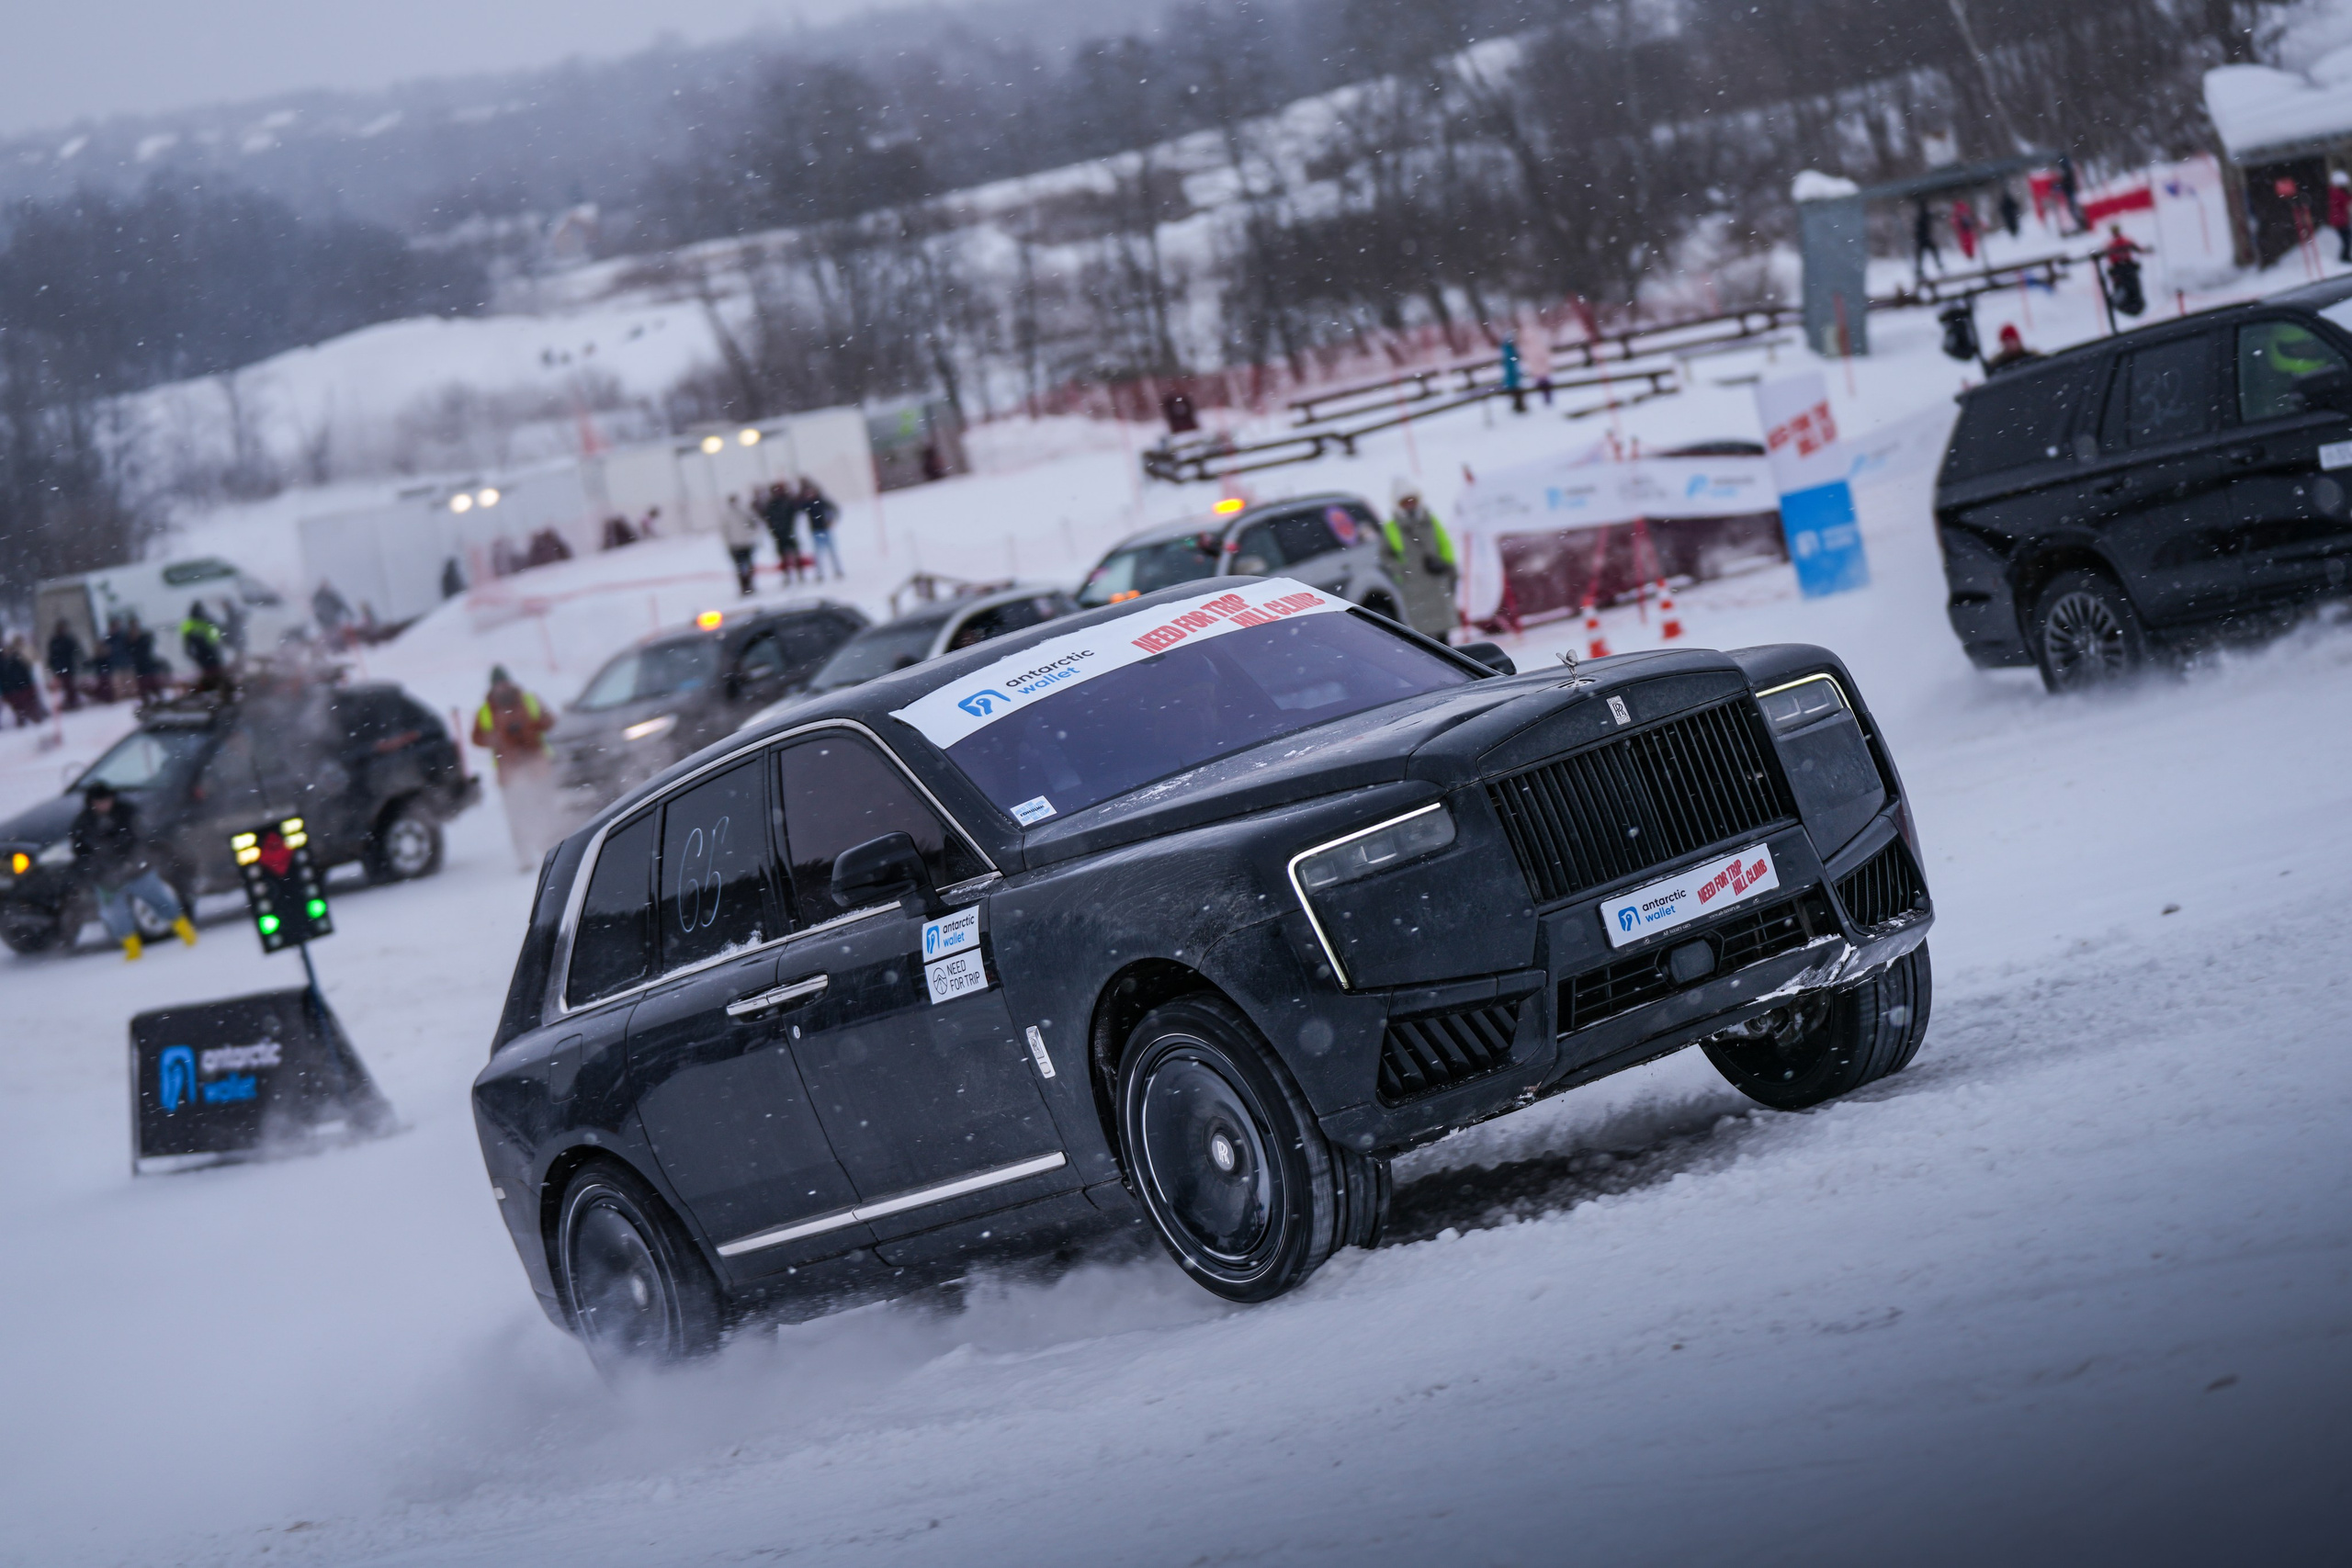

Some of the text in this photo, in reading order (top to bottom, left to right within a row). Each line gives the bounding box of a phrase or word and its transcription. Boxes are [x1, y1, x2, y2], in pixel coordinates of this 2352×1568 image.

[1131, 593, 1250, 654] NEED FOR TRIP
[1228, 592, 1326, 628] HILL CLIMB
[1006, 649, 1095, 687] antarctic
[1017, 667, 1080, 694] wallet
[678, 816, 729, 932] 65
[1697, 859, 1742, 905] NEED FOR TRIP
[1732, 858, 1768, 897] HILL CLIMB
[1642, 889, 1687, 912] antarctic
[1645, 905, 1676, 922] wallet
[943, 914, 975, 934] antarctic
[943, 931, 965, 948] wallet
[946, 959, 967, 976] NEED
[949, 971, 980, 992] FOR TRIP
